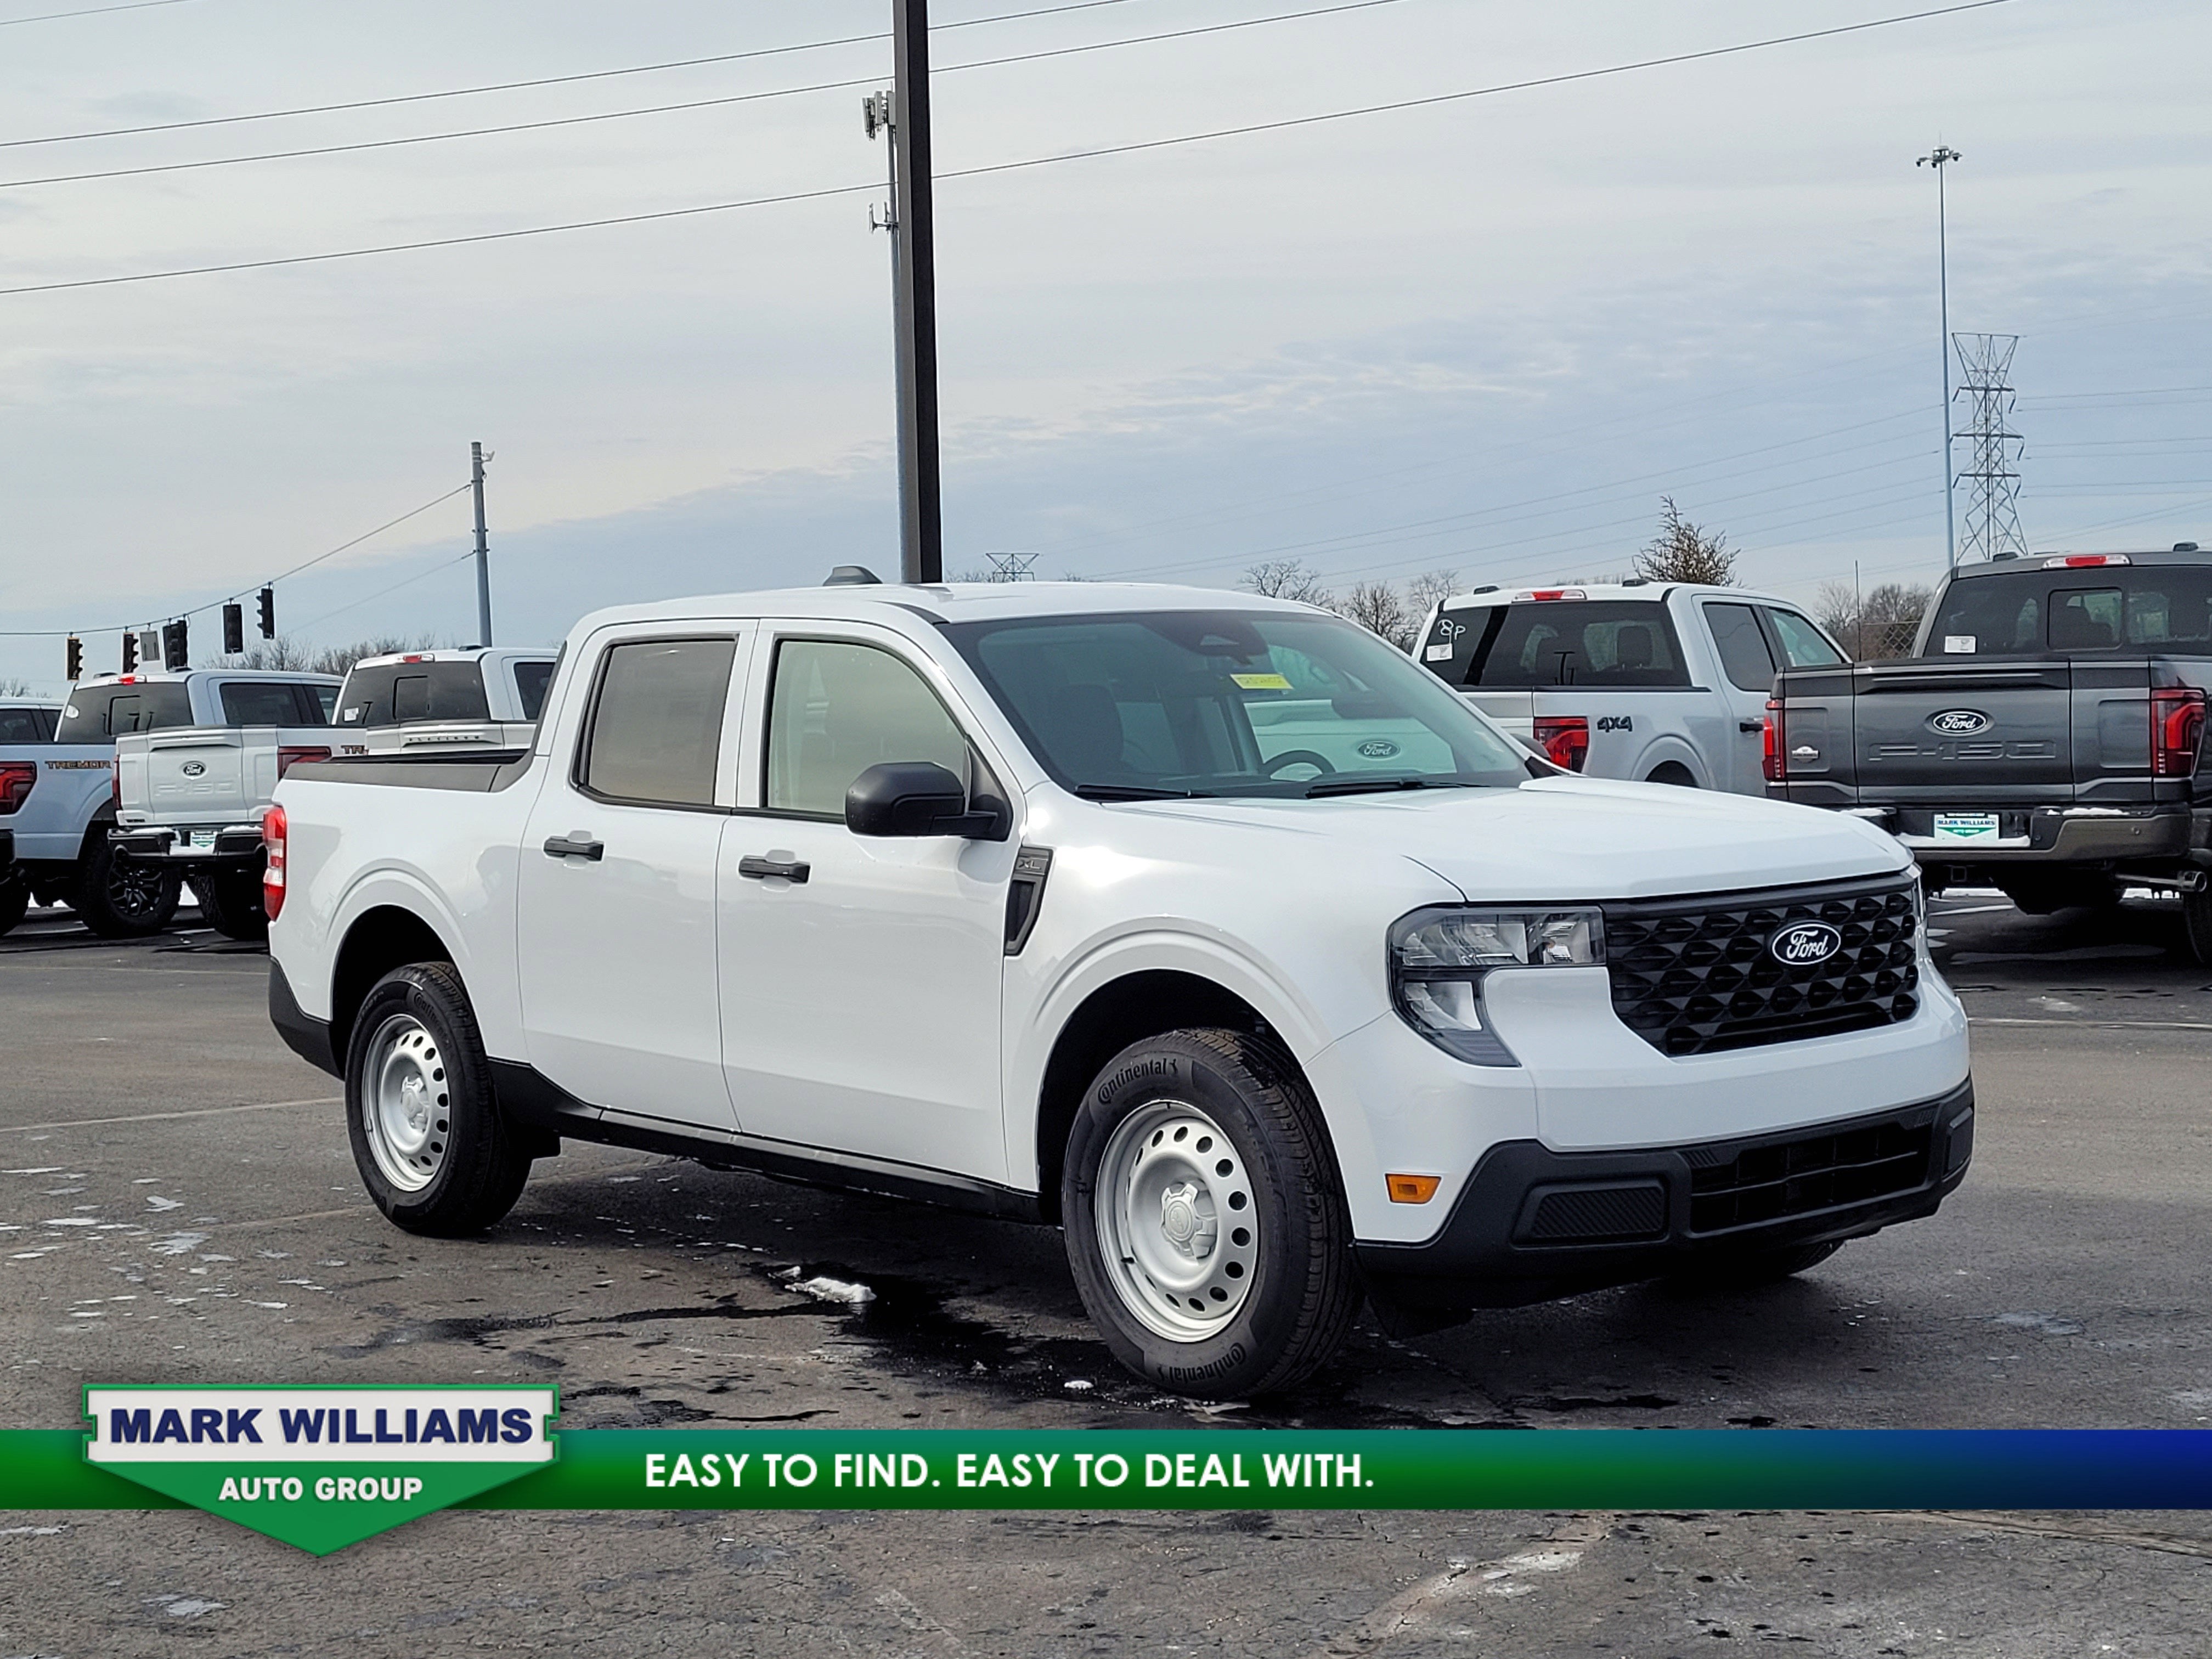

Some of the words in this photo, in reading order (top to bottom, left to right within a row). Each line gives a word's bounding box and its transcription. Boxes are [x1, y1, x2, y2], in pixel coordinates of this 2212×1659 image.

[1942, 715, 1977, 729] Ford
[1364, 743, 1391, 755] Ford
[1867, 741, 2055, 761] F-150
[44, 760, 111, 769] TREMOR
[1019, 860, 1042, 870] XL
[1787, 930, 1829, 959] Ford
[1098, 1058, 1167, 1104] Continental
